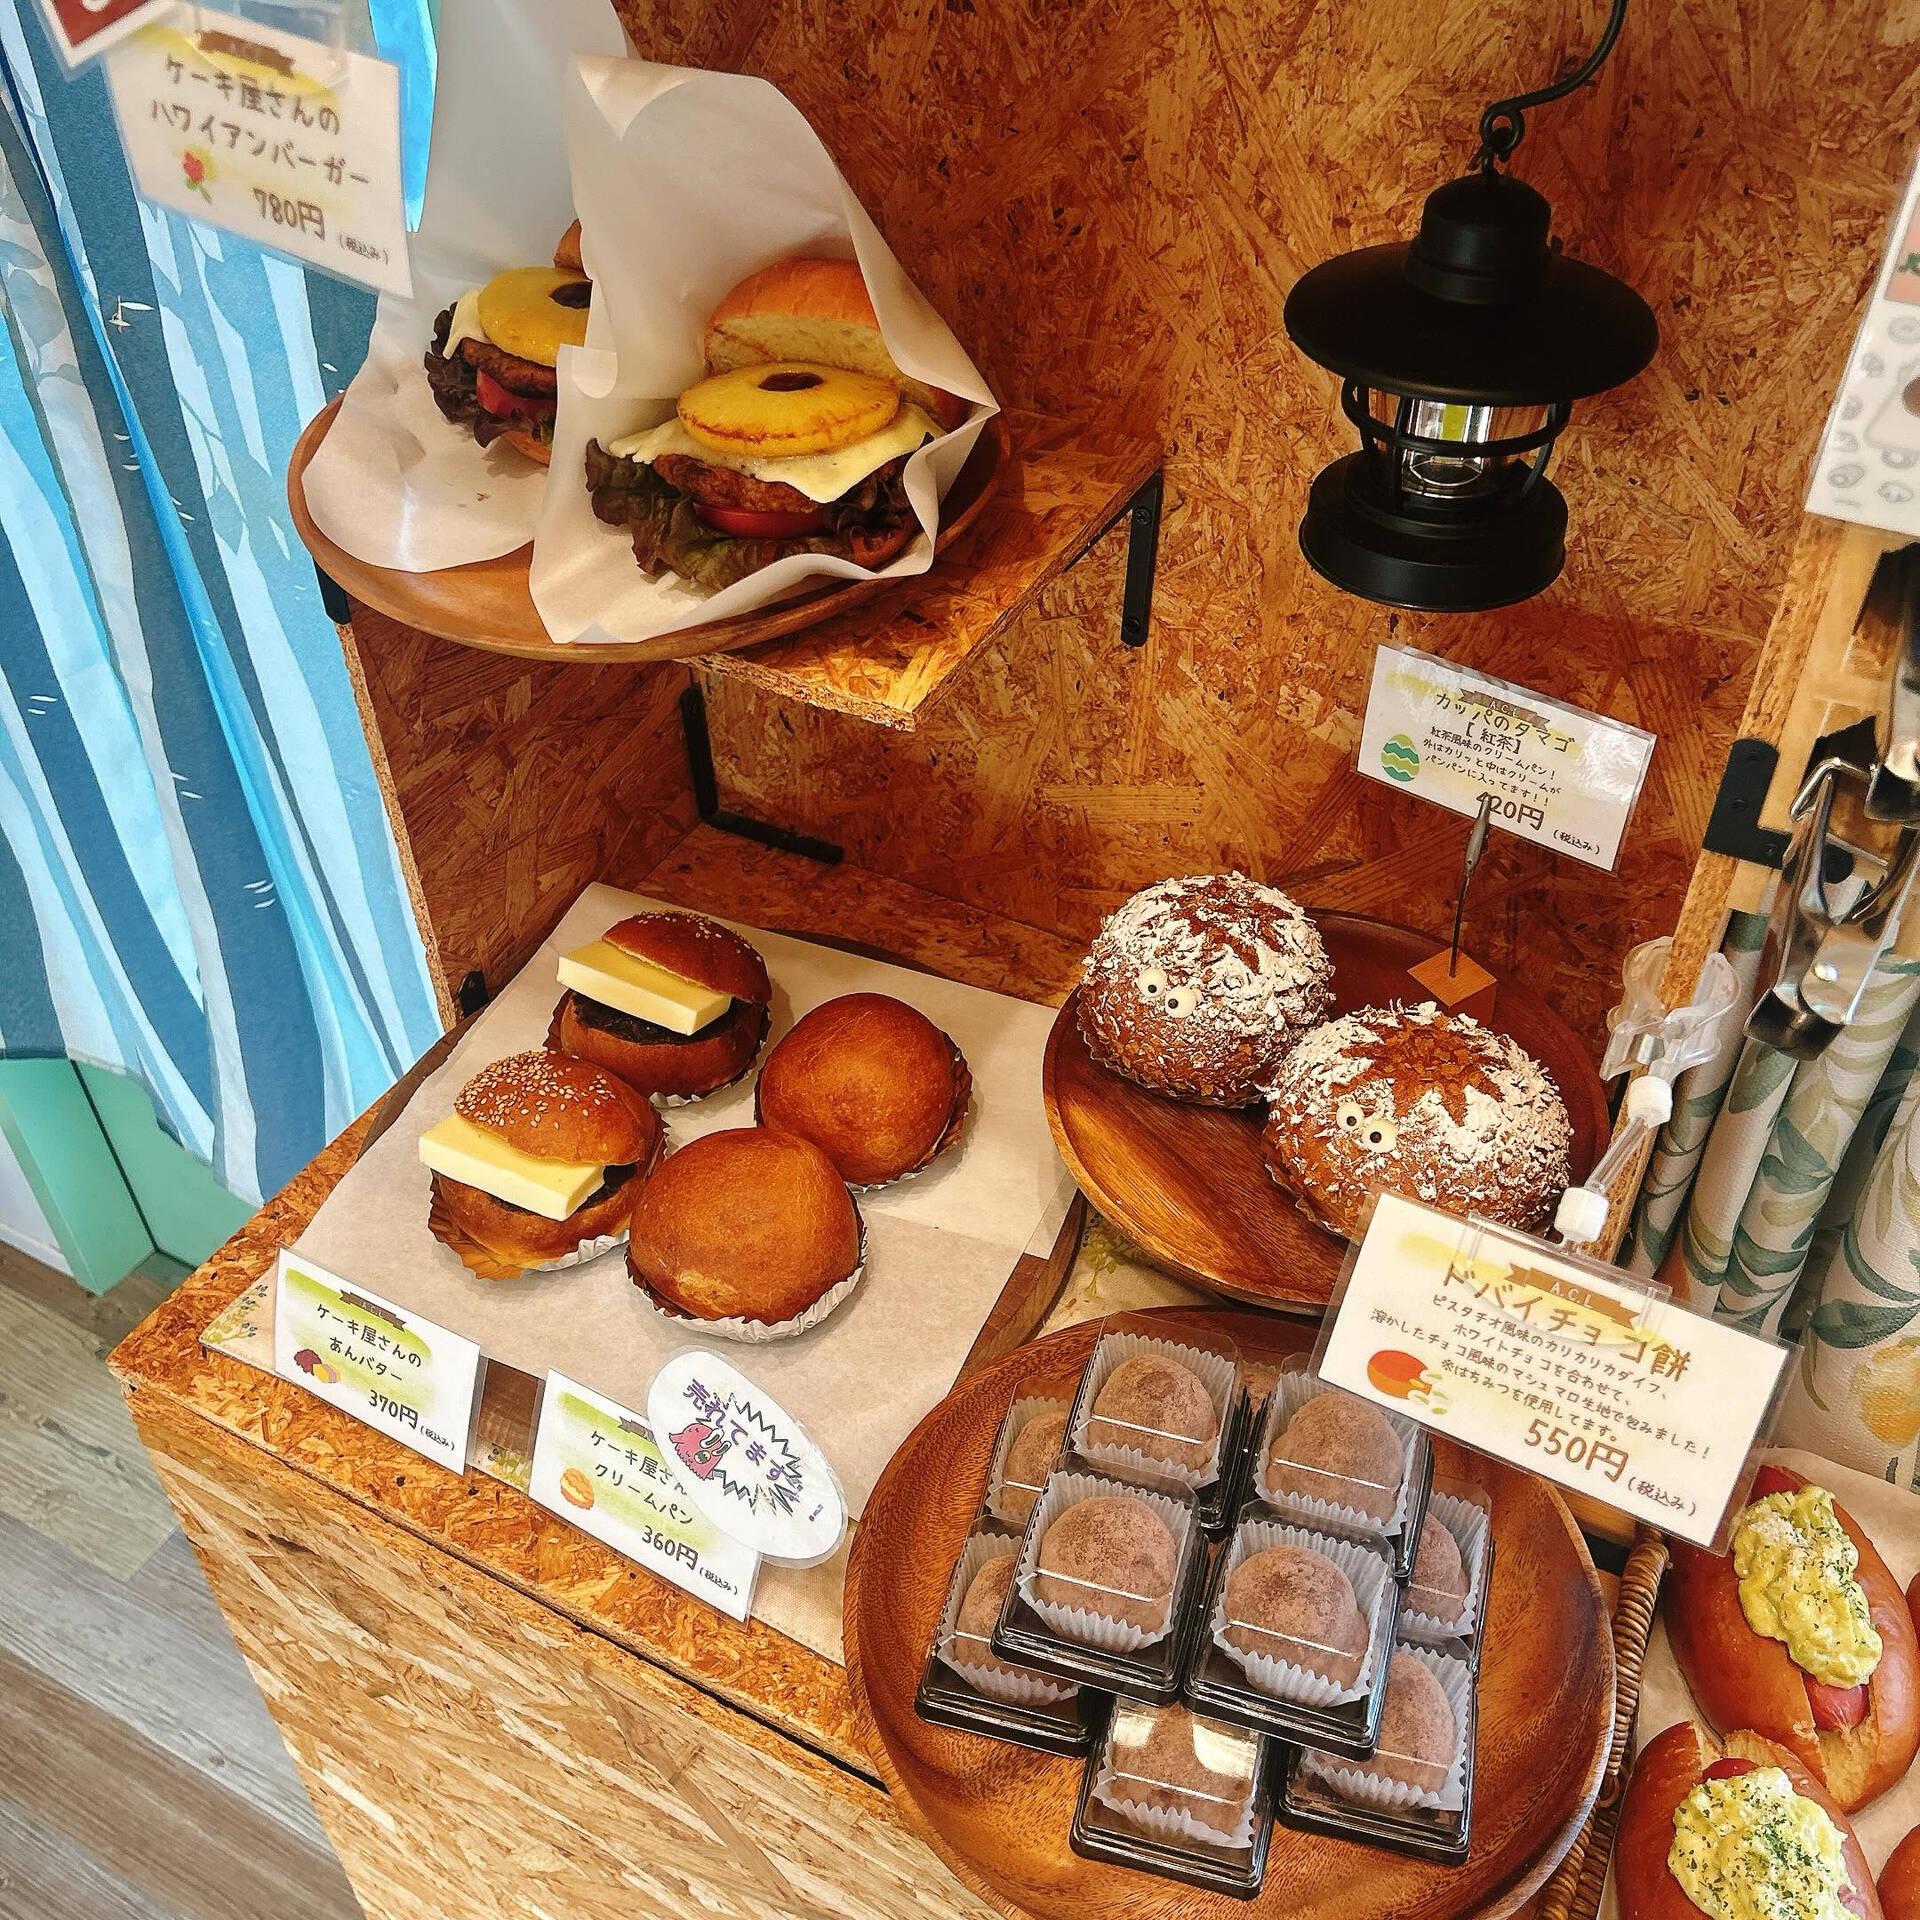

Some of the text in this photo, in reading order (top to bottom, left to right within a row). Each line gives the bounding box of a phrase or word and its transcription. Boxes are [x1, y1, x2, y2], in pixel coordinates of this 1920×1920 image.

[166, 53, 340, 135] ケーキ屋さんの
[151, 100, 370, 186] ハワイアンバーガー
[252, 187, 325, 241] 780円
[1430, 726, 1555, 780] 紅茶風味のクリームパン！
[1435, 692, 1575, 753] カッパのタマゴ
[1423, 739, 1561, 794] 外はカリッと中はクリームが
[1425, 754, 1548, 806] パンパンに入ってます！！
[316, 1303, 422, 1368] ケーキ屋さんの
[1433, 1293, 1669, 1400] ピスタチオ風味のカリカリカダイフ、
[1442, 1261, 1691, 1383] ドバイチョコ餅
[329, 1336, 403, 1381] あんバター
[1370, 1308, 1711, 1459] 溶かしたチョコ風味のマシュマロ生地で包みました！
[1453, 1323, 1631, 1406] ホワイトチョコを合わせて、
[368, 1389, 419, 1430] 370円
[1441, 1358, 1618, 1443] ※はちみつを使用してます。
[1524, 1418, 1628, 1483] 550円
[594, 1463, 693, 1525] クリームパン
[641, 1524, 699, 1571] 360円
